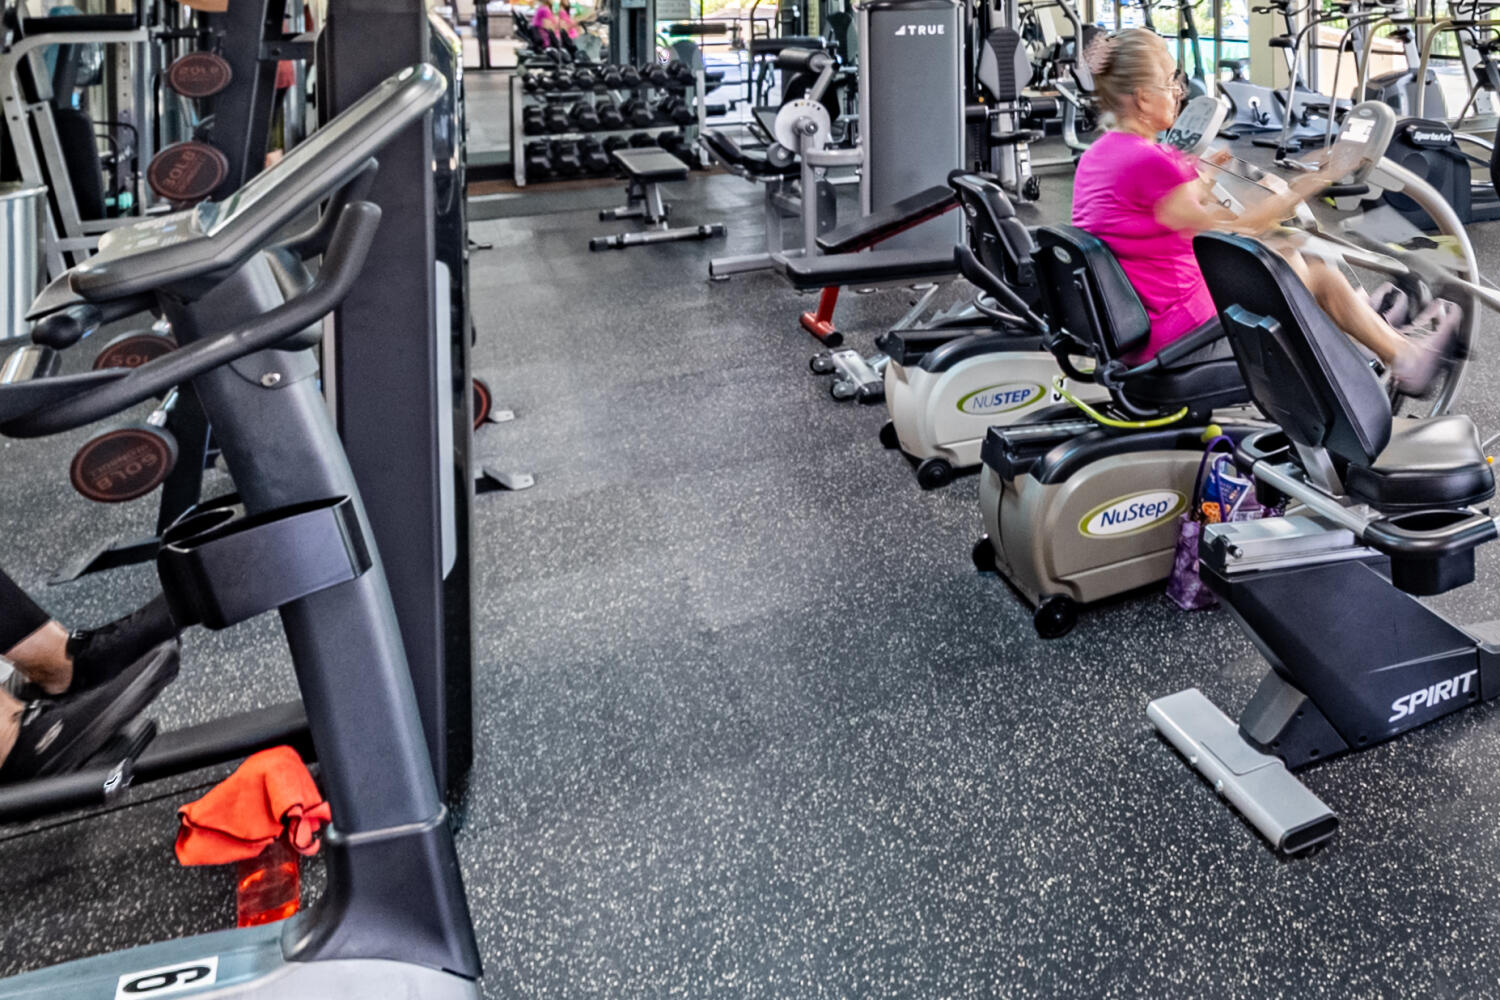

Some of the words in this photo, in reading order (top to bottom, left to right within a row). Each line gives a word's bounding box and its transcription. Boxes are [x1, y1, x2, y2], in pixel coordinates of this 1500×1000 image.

[908, 24, 945, 36] TRUE
[972, 388, 1031, 409] NUSTEP
[1100, 500, 1169, 527] NuStep
[1388, 668, 1478, 723] SPIRIT
